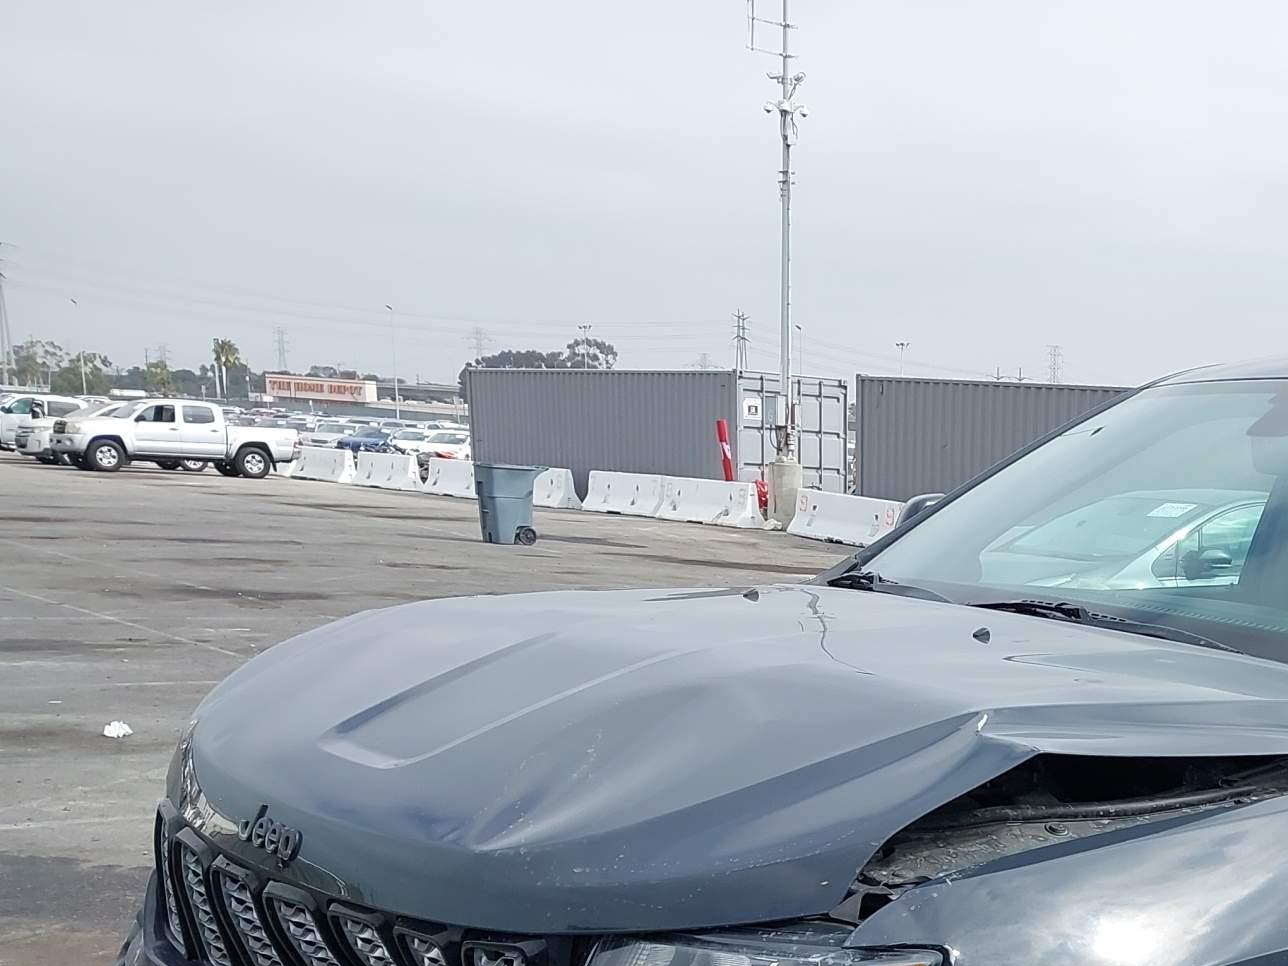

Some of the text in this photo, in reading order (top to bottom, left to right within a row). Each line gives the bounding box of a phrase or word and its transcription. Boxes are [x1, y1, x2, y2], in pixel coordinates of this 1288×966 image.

[270, 380, 362, 396] THE HOME DEPOT
[238, 803, 304, 861] Jeep
